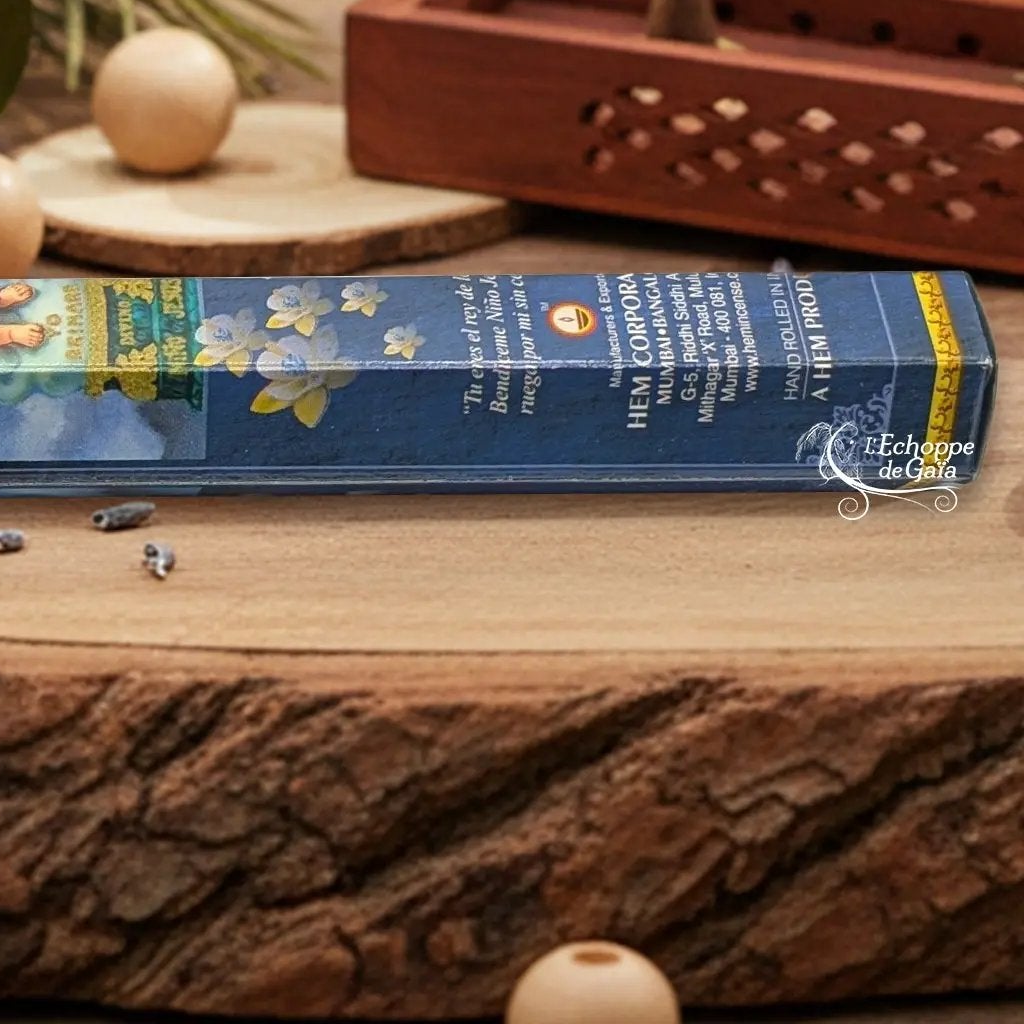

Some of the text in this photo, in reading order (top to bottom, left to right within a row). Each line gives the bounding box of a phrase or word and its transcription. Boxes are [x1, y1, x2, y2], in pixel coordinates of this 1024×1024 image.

[455, 284, 474, 300] de
[483, 290, 504, 322] Niño
[509, 290, 528, 309] sin
[667, 284, 689, 320] Siddhi
[709, 281, 725, 307] 081,
[770, 283, 784, 296] IN
[463, 303, 481, 325] rey
[512, 312, 532, 331] mi
[593, 273, 623, 387] Manufacturers & Export
[692, 301, 710, 336] Road,
[714, 310, 731, 333] 400
[773, 299, 799, 350] ROLLED
[460, 328, 481, 343] el
[521, 333, 542, 361] por
[616, 273, 653, 428] HEM CORPORA
[642, 273, 675, 404] MUMBAI•BANGAL
[677, 324, 699, 363] Riddhi
[469, 346, 484, 379] eres
[720, 344, 739, 402] Mumbai
[808, 336, 832, 378] HEM
[680, 368, 701, 401] G-5,
[697, 357, 722, 422] Mithagar
[784, 354, 802, 400] HAND
[811, 386, 828, 401] A
